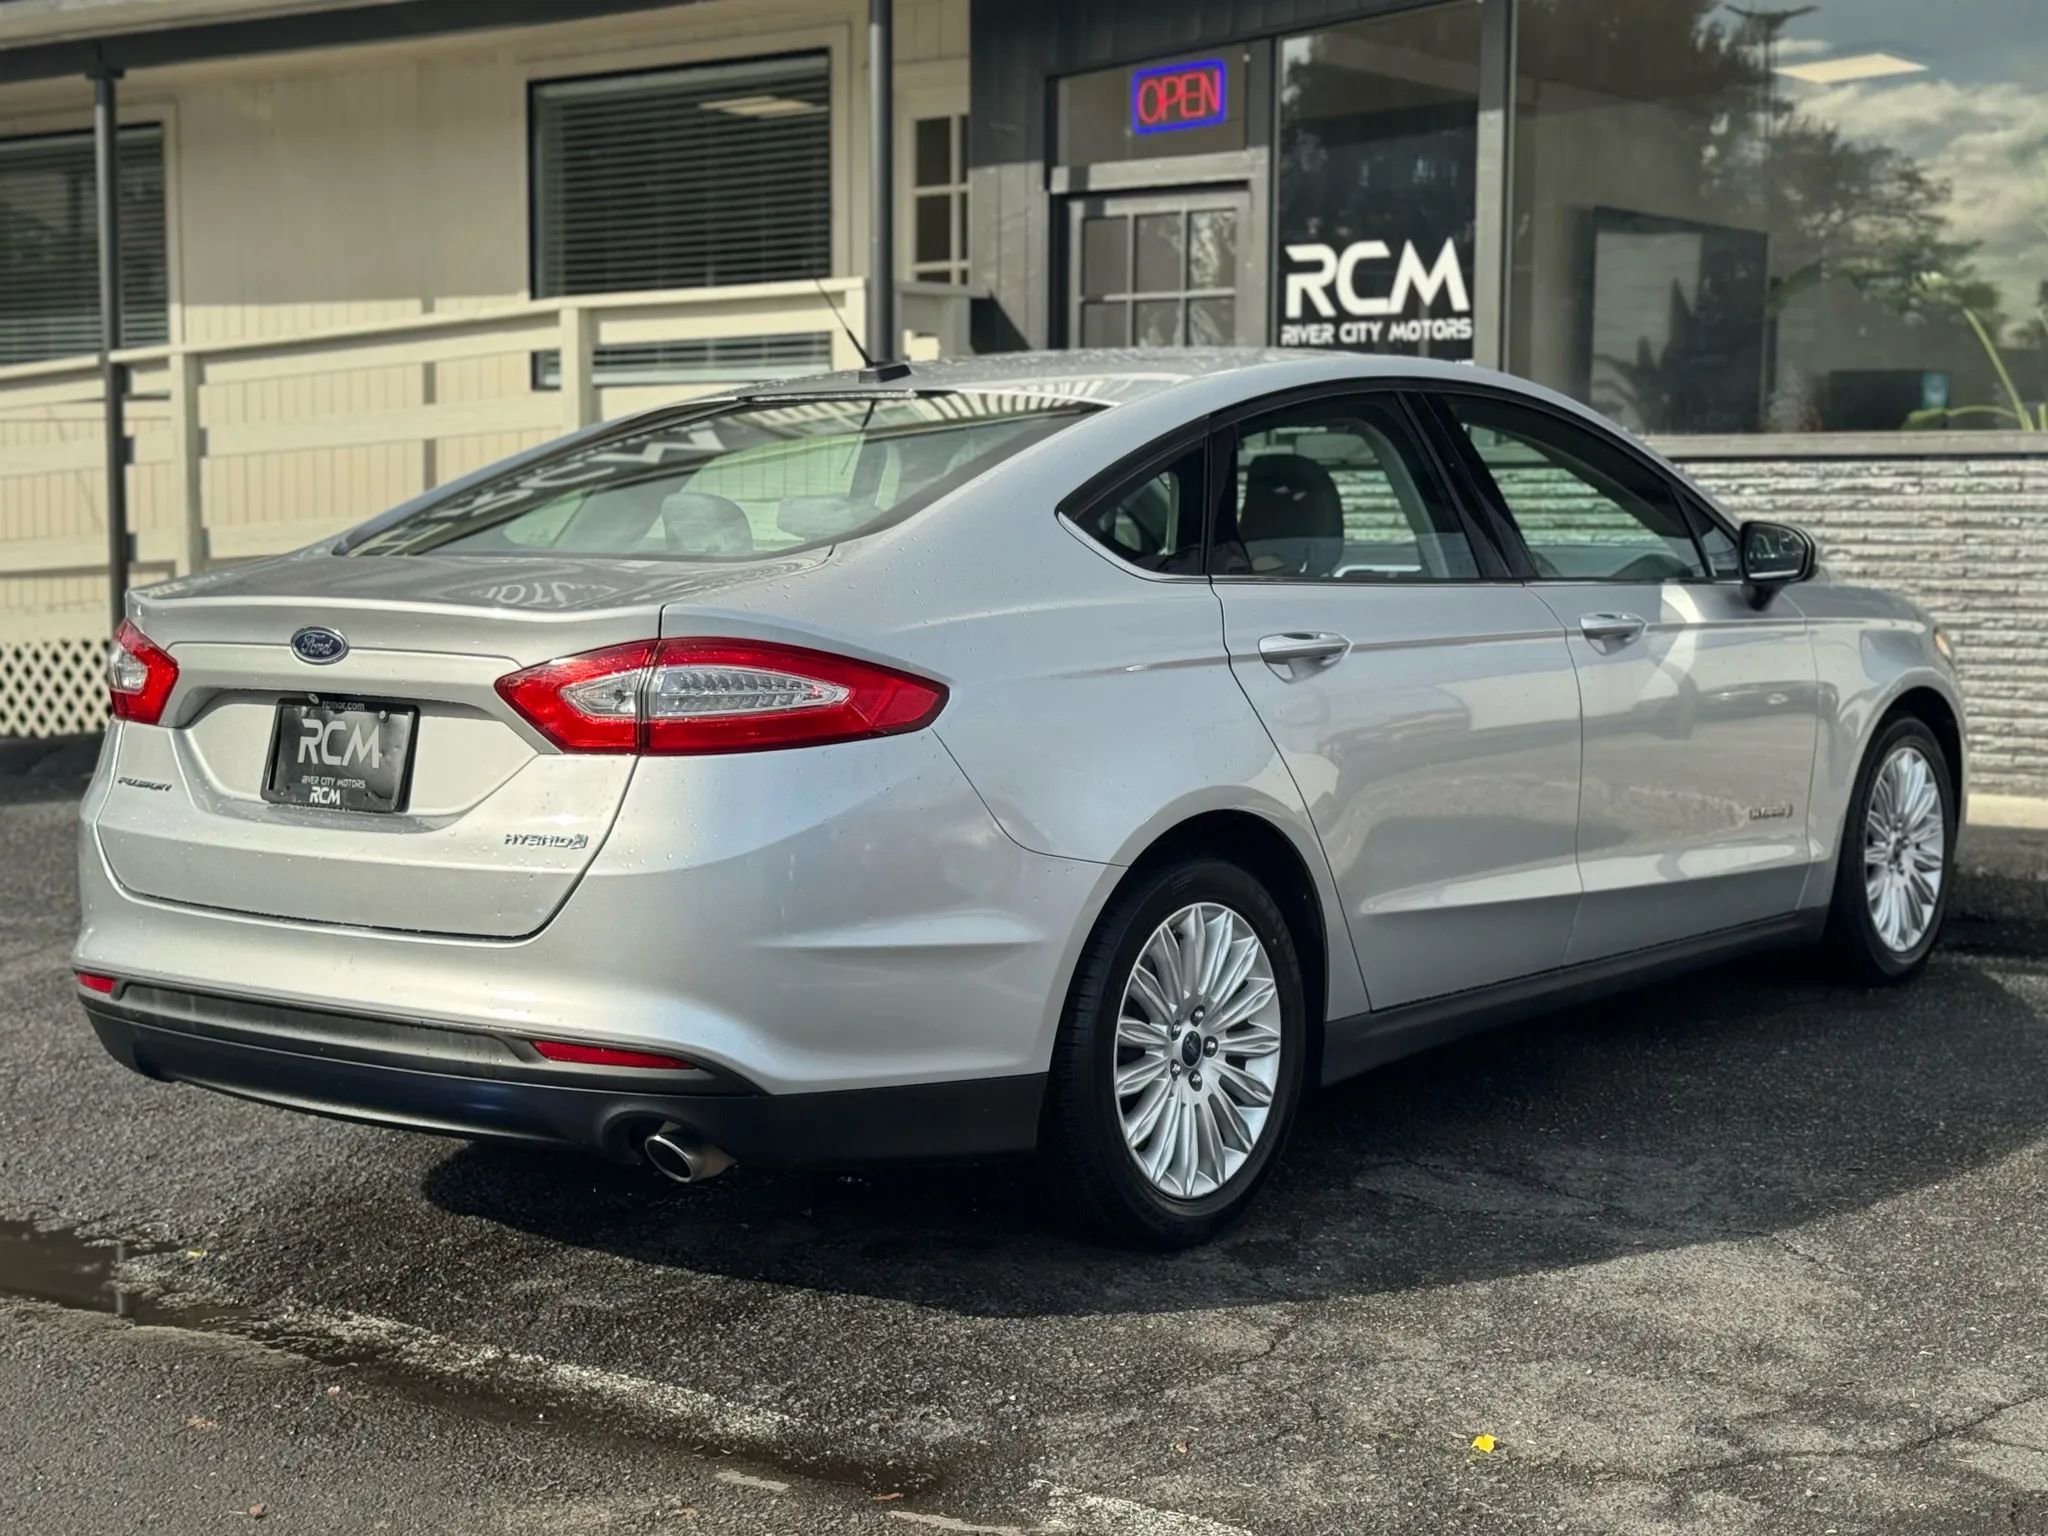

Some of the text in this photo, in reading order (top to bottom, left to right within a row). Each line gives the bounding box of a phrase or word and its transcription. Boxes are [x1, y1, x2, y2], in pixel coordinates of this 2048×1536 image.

[1138, 68, 1220, 124] OPEN
[1285, 237, 1470, 319] RCM
[1281, 317, 1473, 346] RIVER CITY MOTORS
[300, 633, 334, 655] Ford
[297, 718, 380, 769] RCM
[301, 775, 366, 789] RIVER CITY MOTORS
[309, 786, 340, 806] RCM
